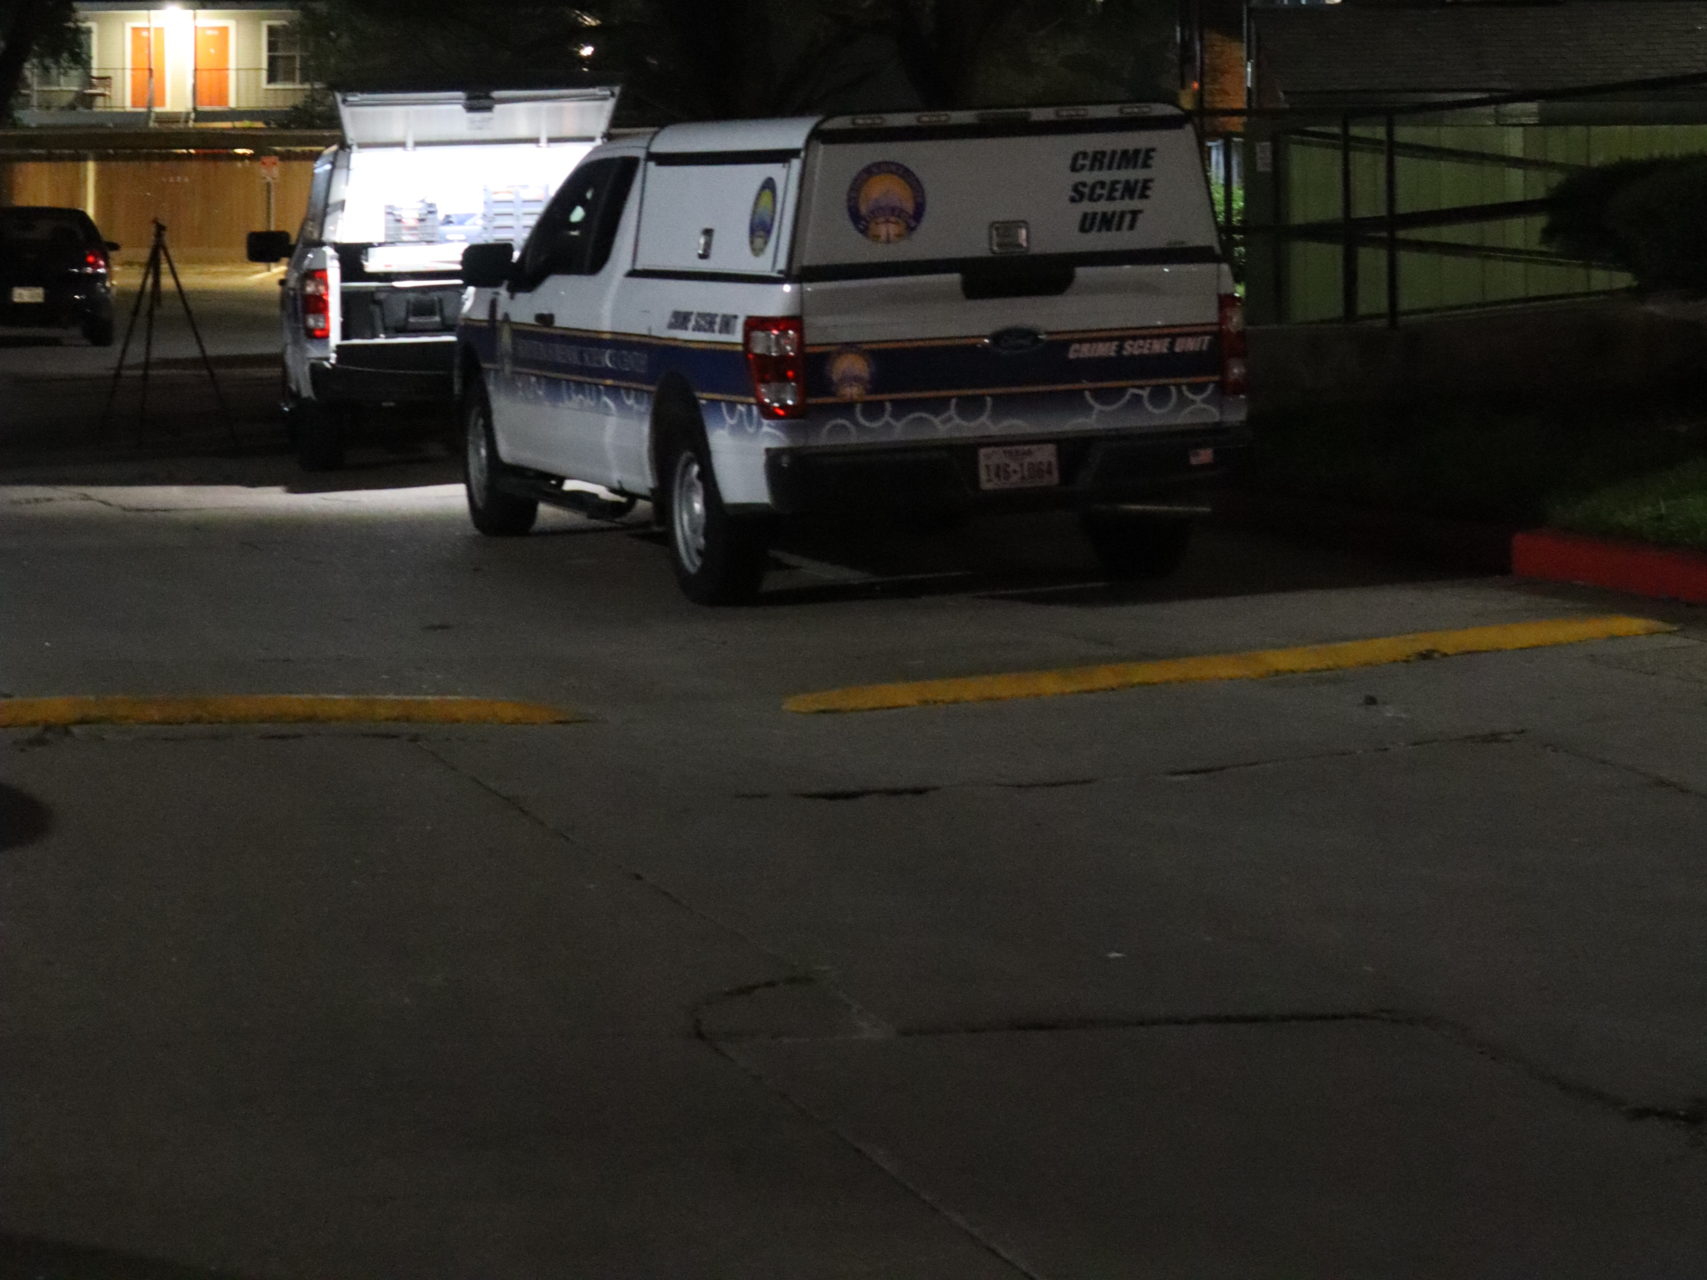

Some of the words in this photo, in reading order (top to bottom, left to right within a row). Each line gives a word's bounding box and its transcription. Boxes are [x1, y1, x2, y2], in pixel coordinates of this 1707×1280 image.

[1069, 147, 1157, 172] CRIME
[1068, 178, 1155, 204] SCENE
[1077, 209, 1144, 234] UNIT
[1067, 340, 1120, 359] CRIME
[1121, 337, 1172, 356] SCENE
[1174, 335, 1213, 353] UNIT
